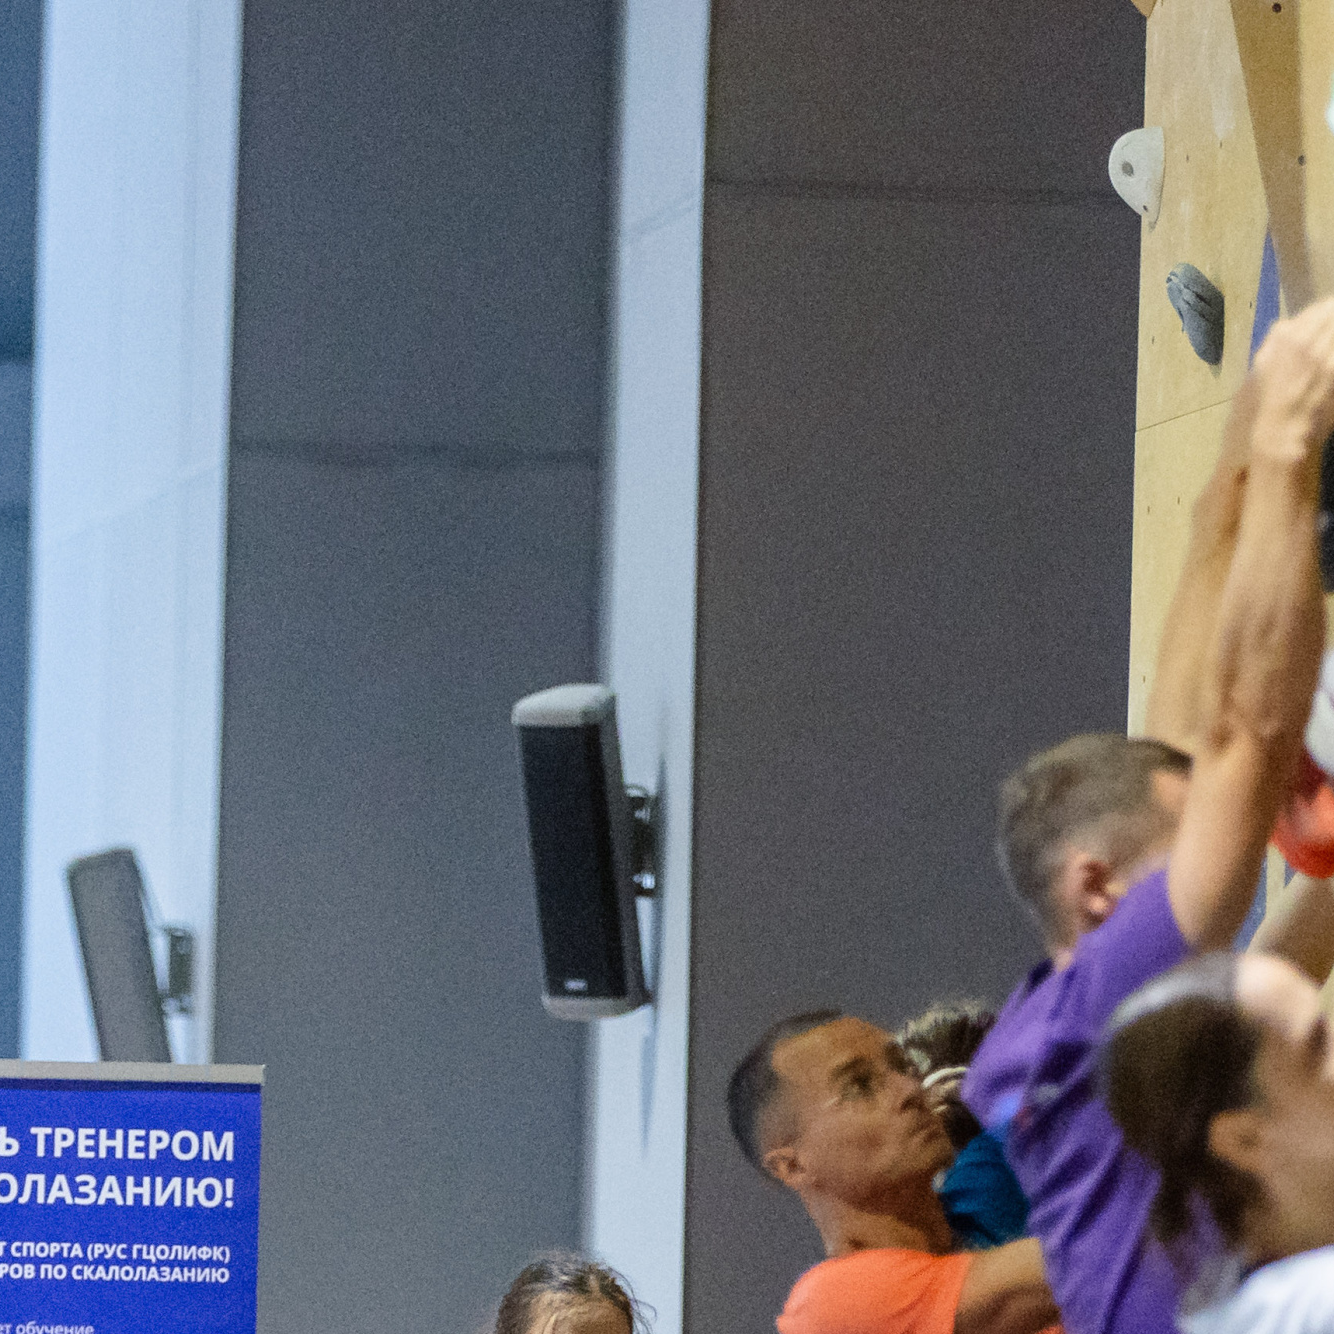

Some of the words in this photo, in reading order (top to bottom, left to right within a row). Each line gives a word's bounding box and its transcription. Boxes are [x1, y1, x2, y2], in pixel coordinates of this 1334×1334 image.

[29, 1126, 234, 1161] ТРЕНЕРОМ
[10, 1241, 83, 1257] СПОРТА
[87, 1243, 127, 1259] (РУС
[132, 1244, 230, 1261] ГЦОЛИФК)
[39, 1263, 68, 1279] ПО
[71, 1264, 230, 1283] СКАЛОЛАЗАНИЮ
